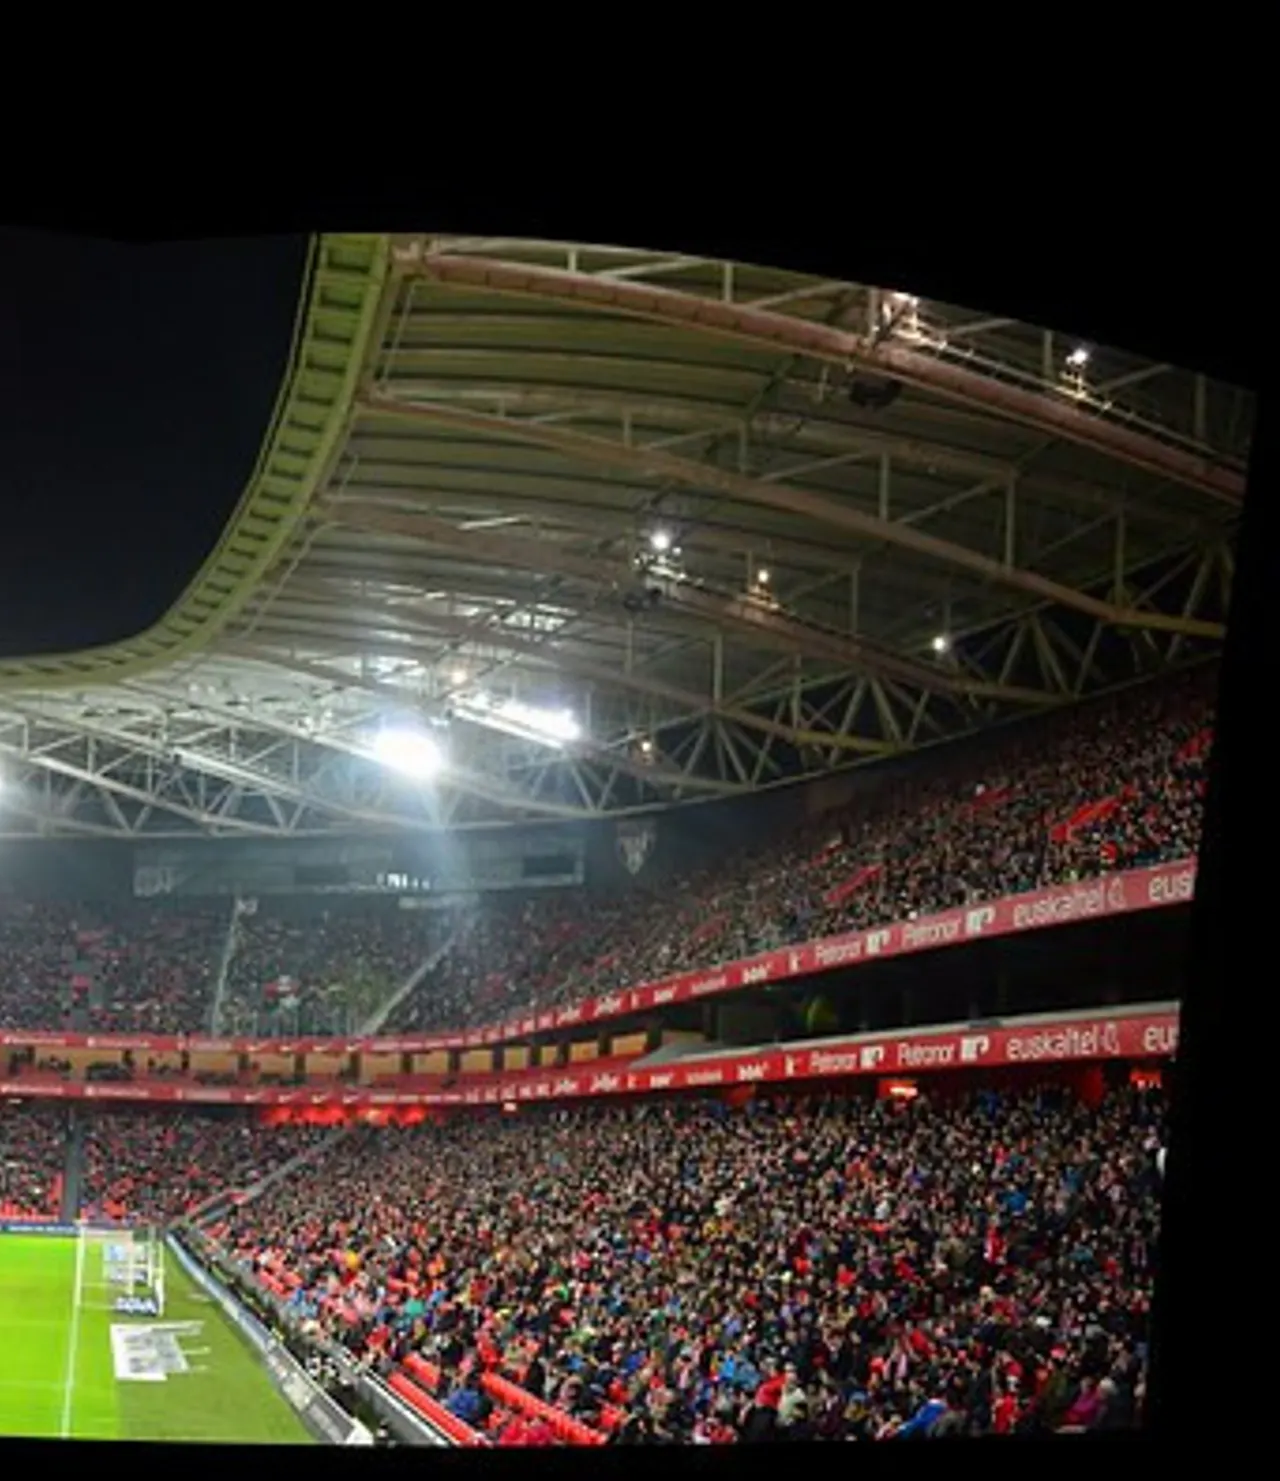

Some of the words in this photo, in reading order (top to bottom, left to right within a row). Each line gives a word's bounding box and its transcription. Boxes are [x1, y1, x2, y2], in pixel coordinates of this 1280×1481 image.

[902, 919, 960, 948] Petronor
[1013, 882, 1105, 929] euskaltel
[897, 1042, 955, 1068] Petronor
[1006, 1023, 1099, 1062] euskaltel
